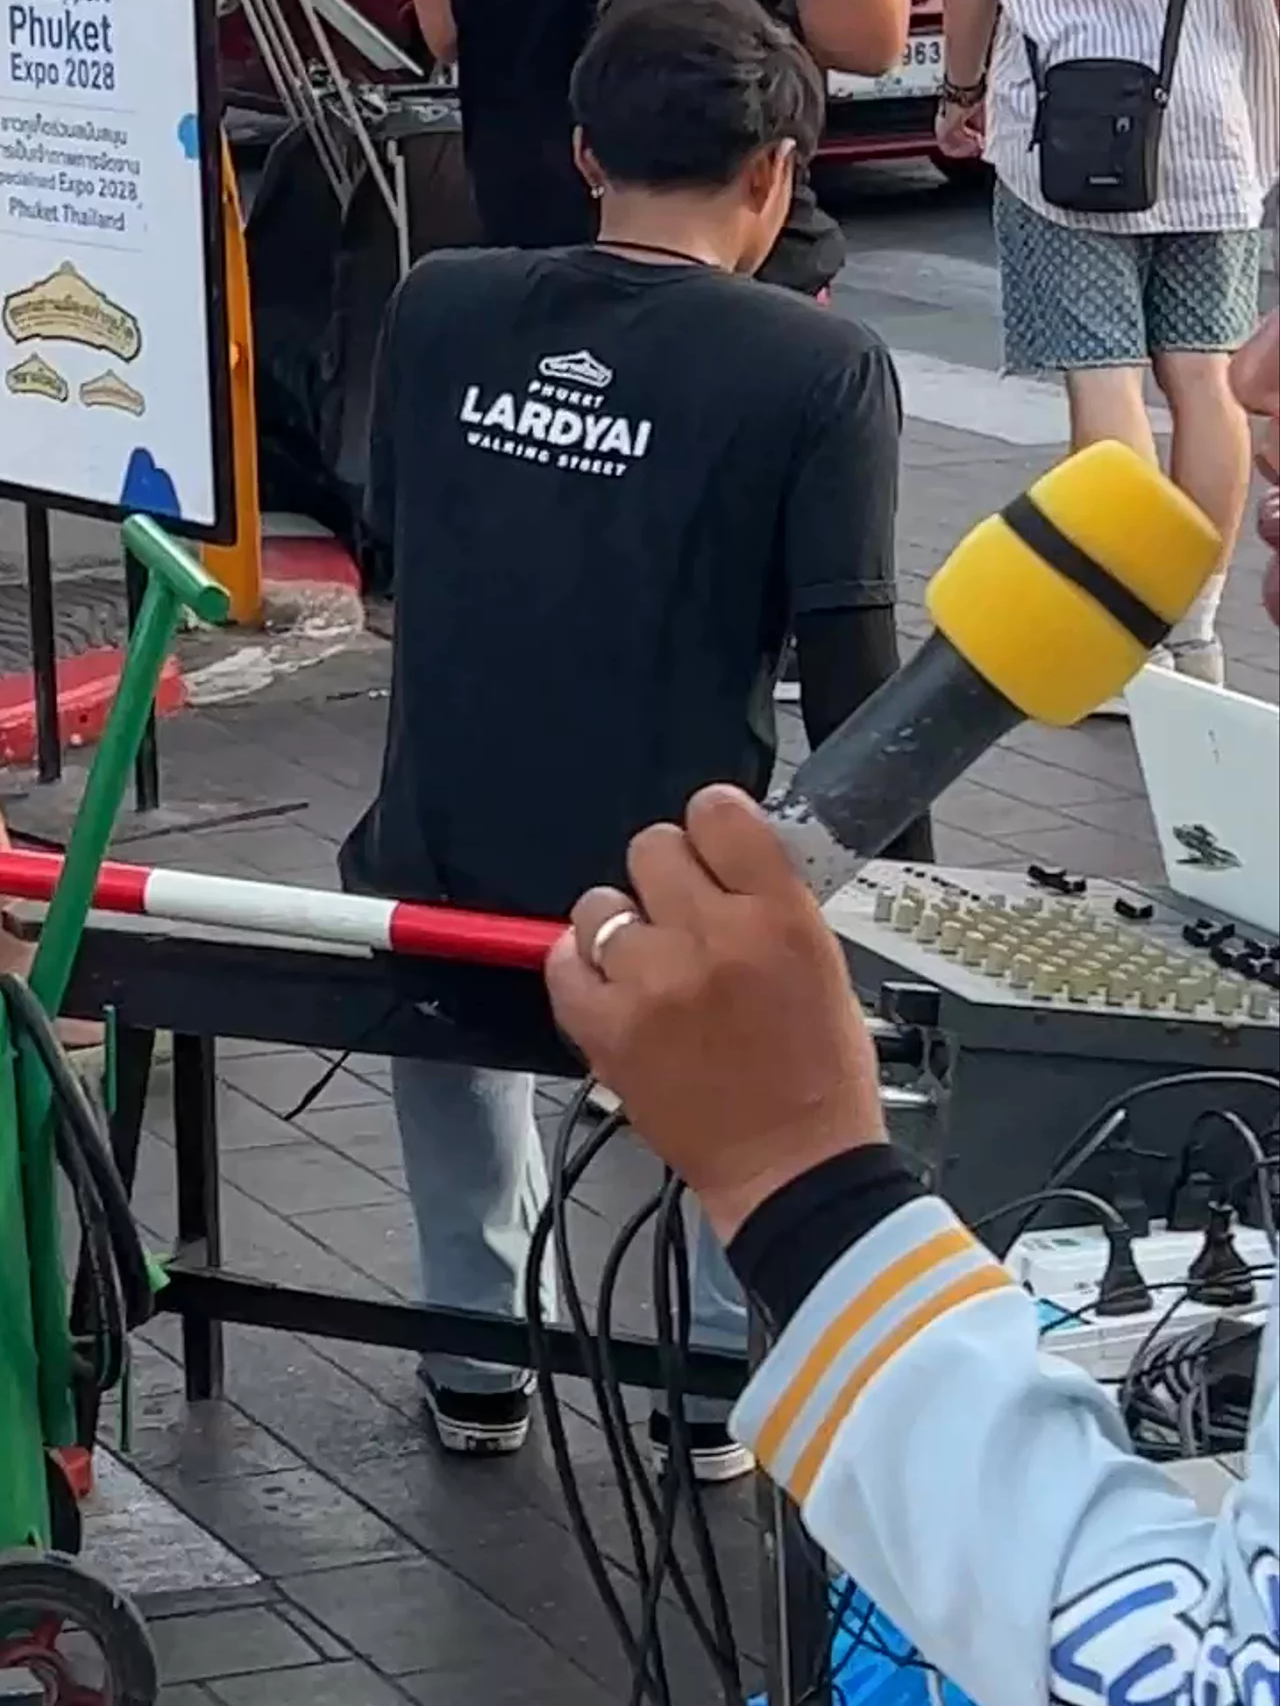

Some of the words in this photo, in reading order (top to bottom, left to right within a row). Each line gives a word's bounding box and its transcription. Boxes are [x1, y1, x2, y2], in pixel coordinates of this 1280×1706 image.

[8, 4, 113, 54] Phuket
[10, 51, 59, 89] Expo
[64, 57, 114, 90] 2028
[58, 171, 94, 199] Expo
[8, 196, 58, 222] Phuket
[62, 203, 124, 231] Thailand
[529, 381, 604, 409] PHUKET
[460, 386, 653, 457] LARDYAI
[467, 431, 550, 464] WALKING
[557, 453, 628, 477] STREET
